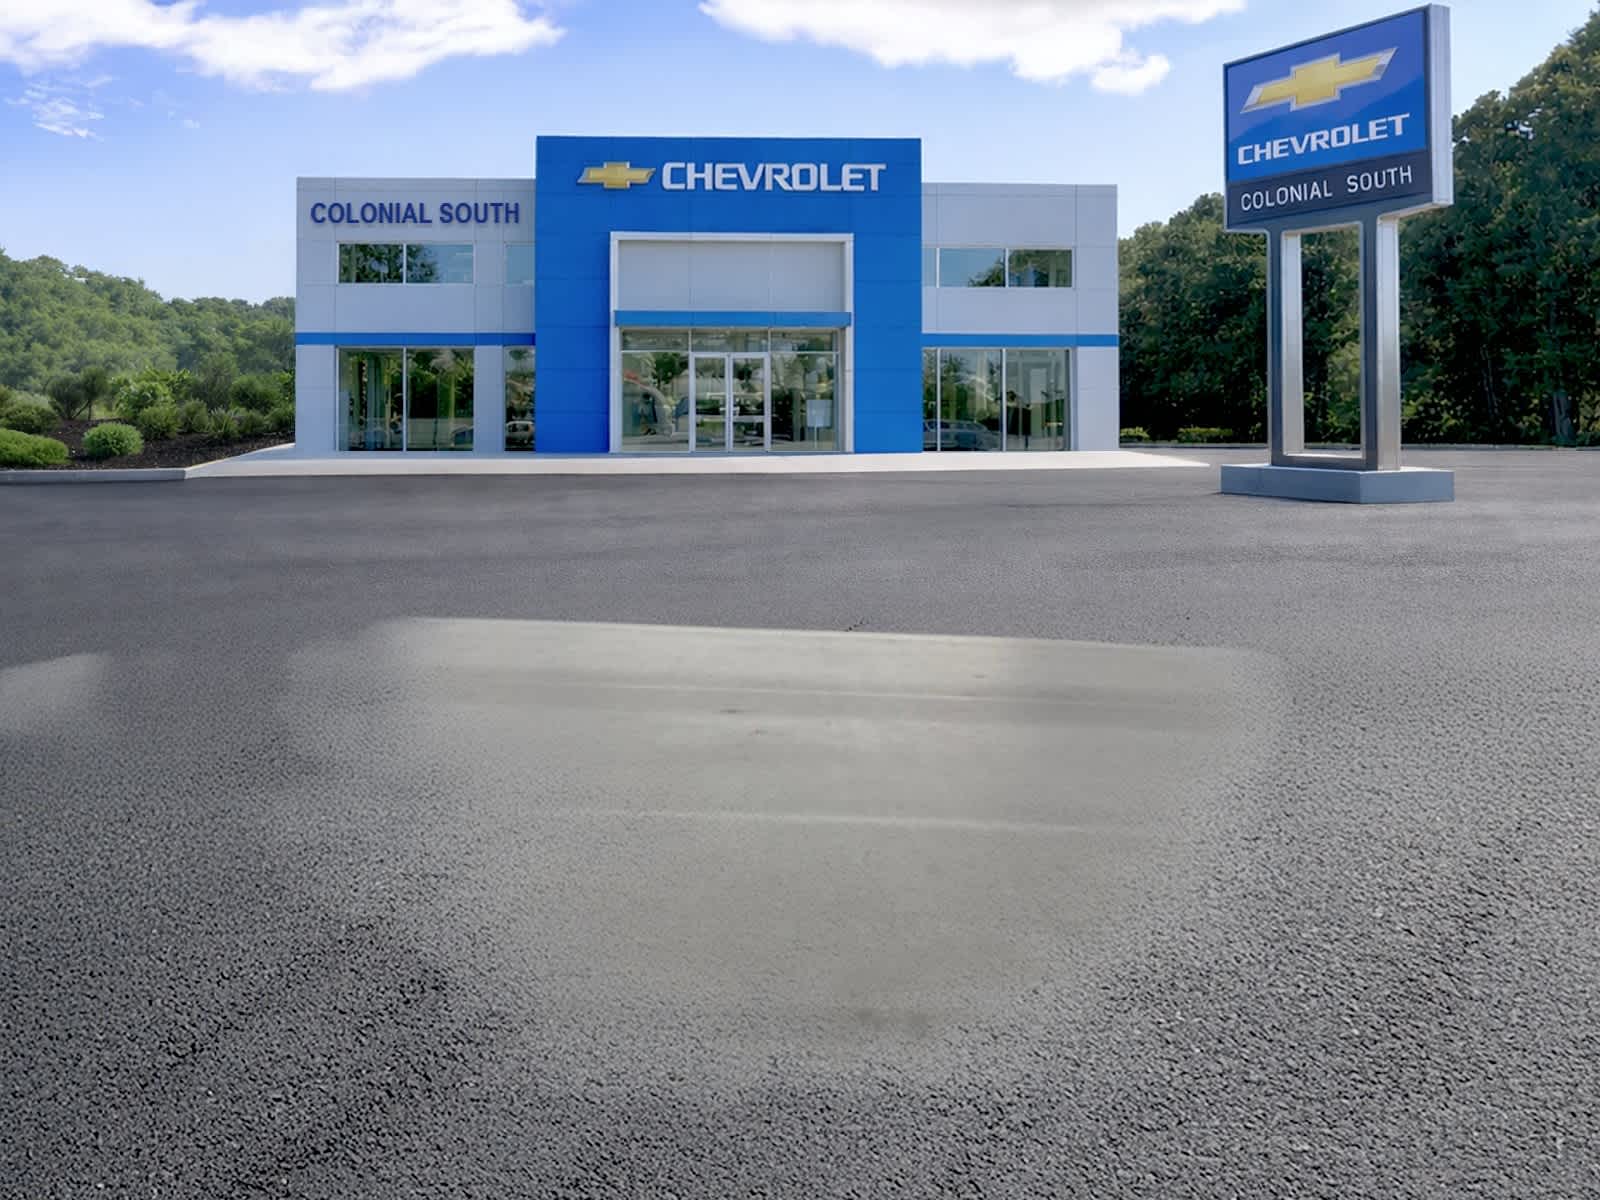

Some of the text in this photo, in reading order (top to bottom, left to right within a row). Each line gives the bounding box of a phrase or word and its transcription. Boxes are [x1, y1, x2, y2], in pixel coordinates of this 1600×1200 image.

[1237, 113, 1410, 165] CHEVROLET
[661, 162, 886, 192] CHEVROLET
[1241, 165, 1413, 211] COLONIAL SOUTH
[310, 202, 521, 225] COLONIAL SOUTH
